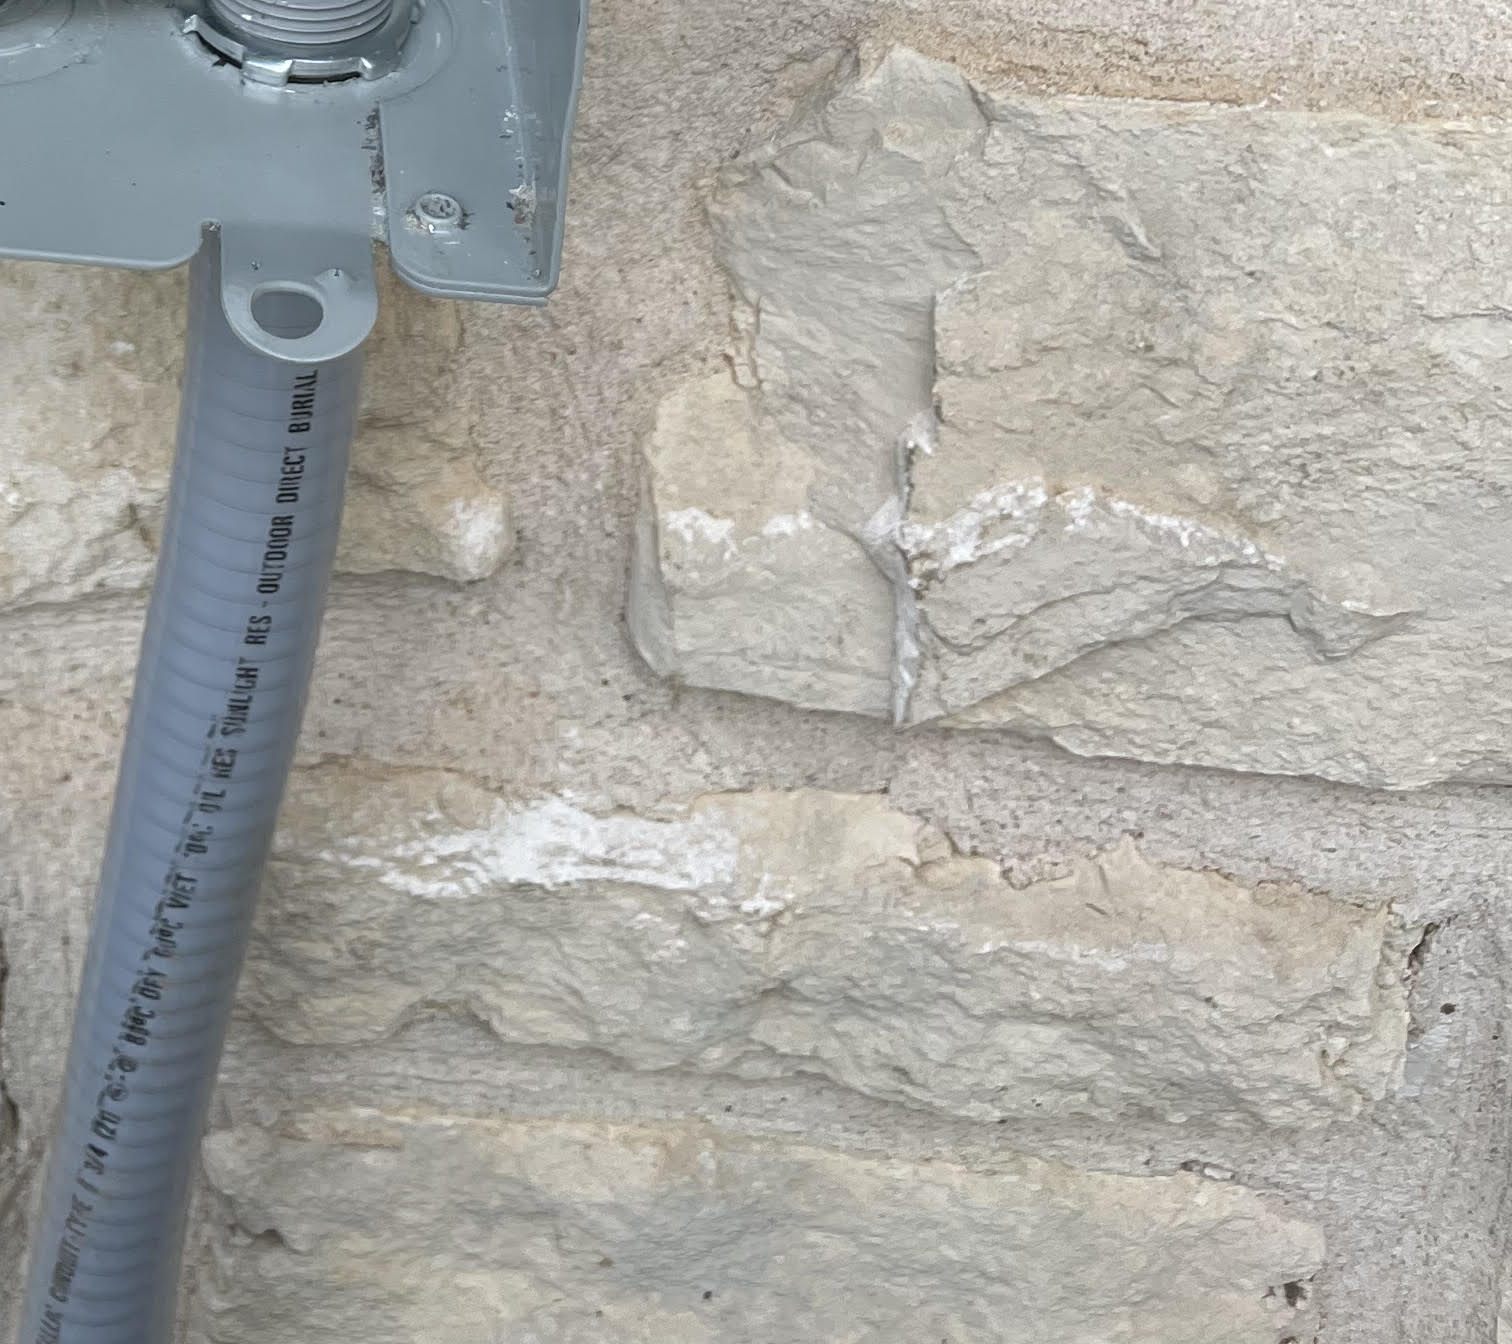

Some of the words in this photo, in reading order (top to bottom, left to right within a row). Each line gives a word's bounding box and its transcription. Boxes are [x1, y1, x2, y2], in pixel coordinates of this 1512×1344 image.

[289, 369, 319, 433] BURIAL
[276, 446, 307, 504] DIRECT
[258, 514, 295, 595] OUTDOOR
[245, 614, 273, 646] RES
